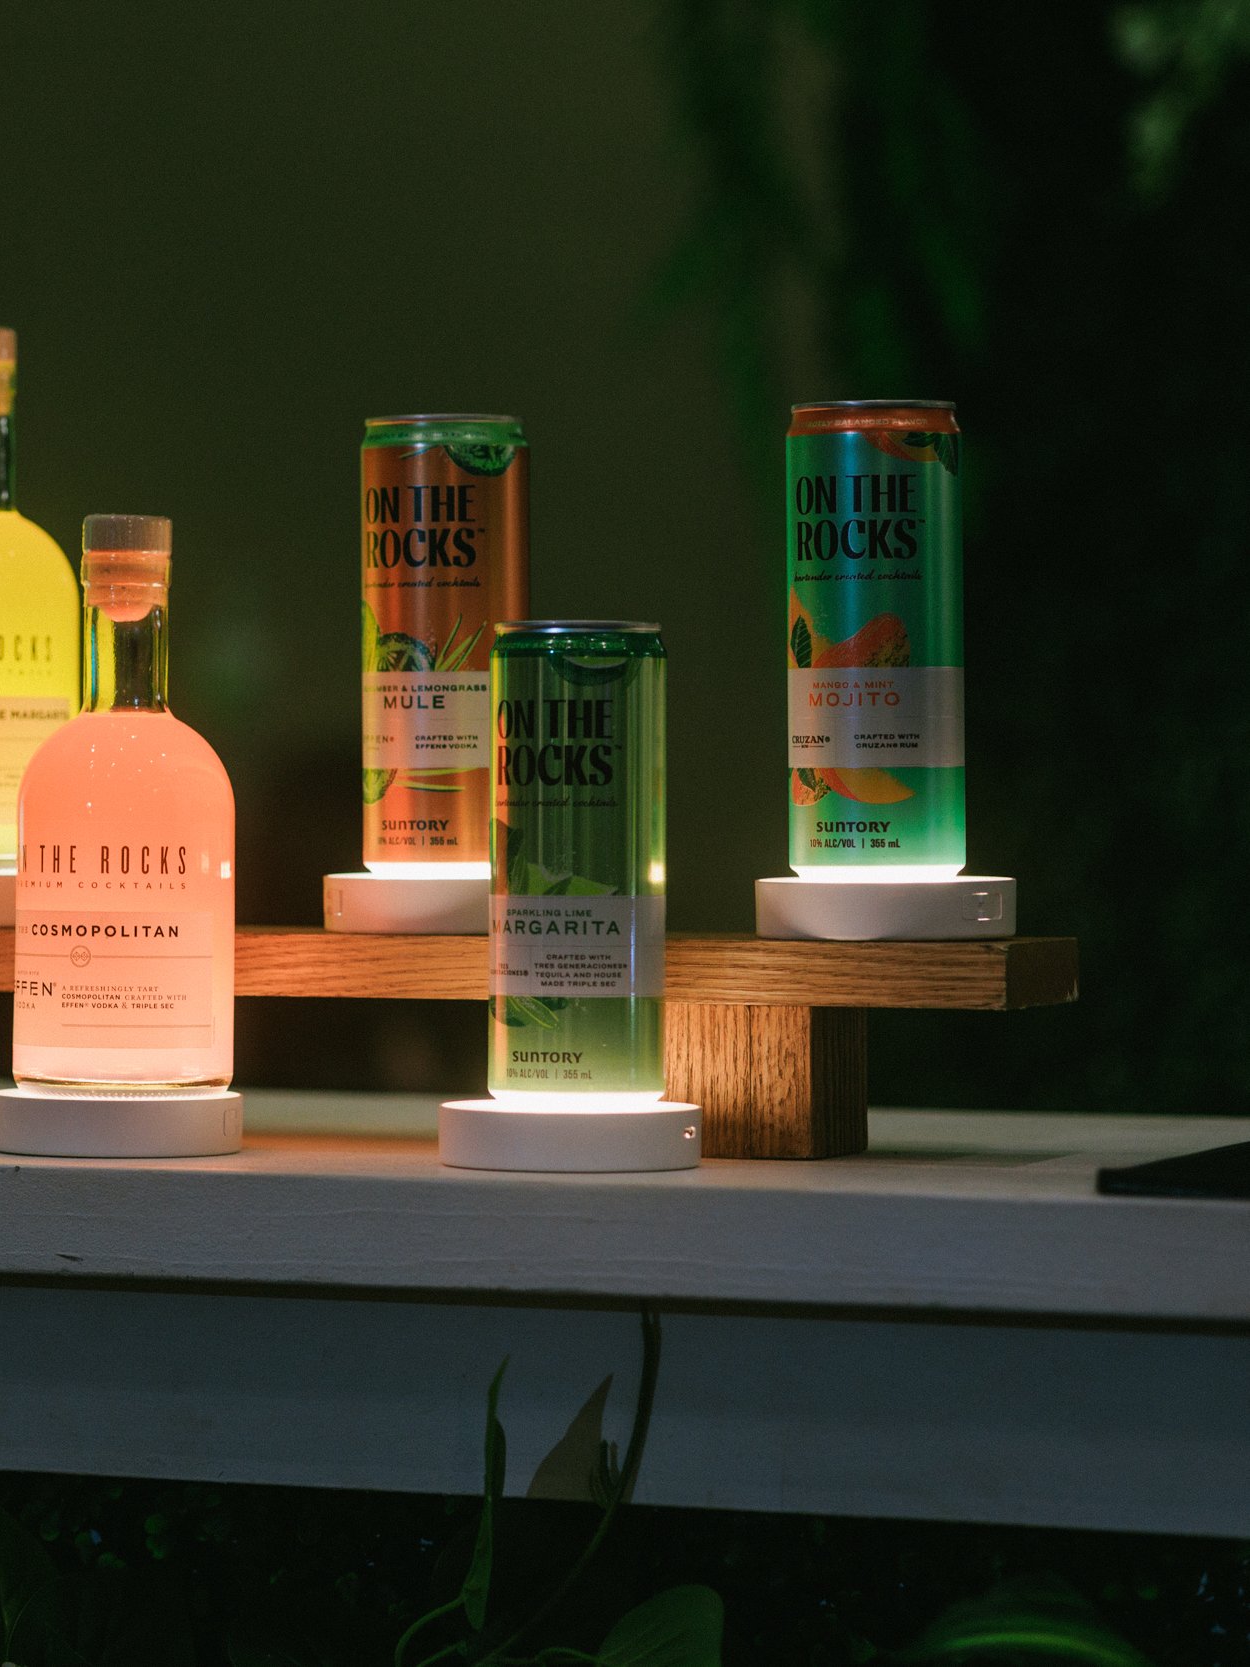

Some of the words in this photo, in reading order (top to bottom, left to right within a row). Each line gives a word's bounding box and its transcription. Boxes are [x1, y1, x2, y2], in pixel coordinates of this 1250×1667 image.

[795, 475, 837, 516] ON
[845, 474, 917, 513] THE
[365, 485, 400, 525] ON
[407, 484, 477, 524] THE
[834, 569, 875, 581] created
[877, 568, 924, 582] cocktails
[401, 684, 409, 693] &
[410, 683, 488, 692] LEMONGRASS
[812, 681, 850, 690] MANGO
[853, 681, 861, 689] &
[864, 680, 895, 689] MINT
[383, 694, 446, 710] MULE
[808, 691, 901, 708] MOJITO
[497, 699, 536, 740] ON
[543, 699, 614, 739] THE
[853, 733, 896, 741] CRAFTED
[897, 733, 921, 741] WITH
[899, 742, 919, 750] RUM
[429, 836, 445, 846] 355
[809, 838, 823, 849] 10%
[824, 838, 856, 849] ALC/VOL
[870, 838, 887, 849] 355
[39, 844, 77, 874] THE
[100, 845, 187, 875] ROCKS
[77, 881, 187, 890] COCKTAILS
[506, 908, 562, 918] SPARKLING
[564, 908, 593, 918] LIME
[30, 923, 180, 939] COSMOPOLITAN
[492, 919, 621, 936] MARGARITA
[545, 953, 587, 961] CRAFTED
[588, 953, 612, 961] WITH
[533, 962, 556, 970] TRES
[534, 971, 571, 980] TEQUILA
[573, 971, 592, 979] AND
[593, 971, 623, 979] HOUSE
[69, 985, 134, 993] REFRESHINGLY
[137, 985, 159, 993] TART
[540, 980, 565, 988] MADE
[567, 980, 598, 988] TRIPLE
[600, 980, 617, 988] SEC
[61, 993, 121, 1001] COSMOPOLITAN
[124, 994, 164, 1002] CRAFTED
[15, 1000, 37, 1010] ODKA
[91, 1002, 120, 1010] VODKA
[121, 1002, 128, 1010] &
[131, 1002, 159, 1010] TRIPLE
[160, 1002, 175, 1010] SEC
[506, 1067, 519, 1079] 10%
[519, 1068, 550, 1080] ALC/VOL
[562, 1069, 579, 1080] 355
